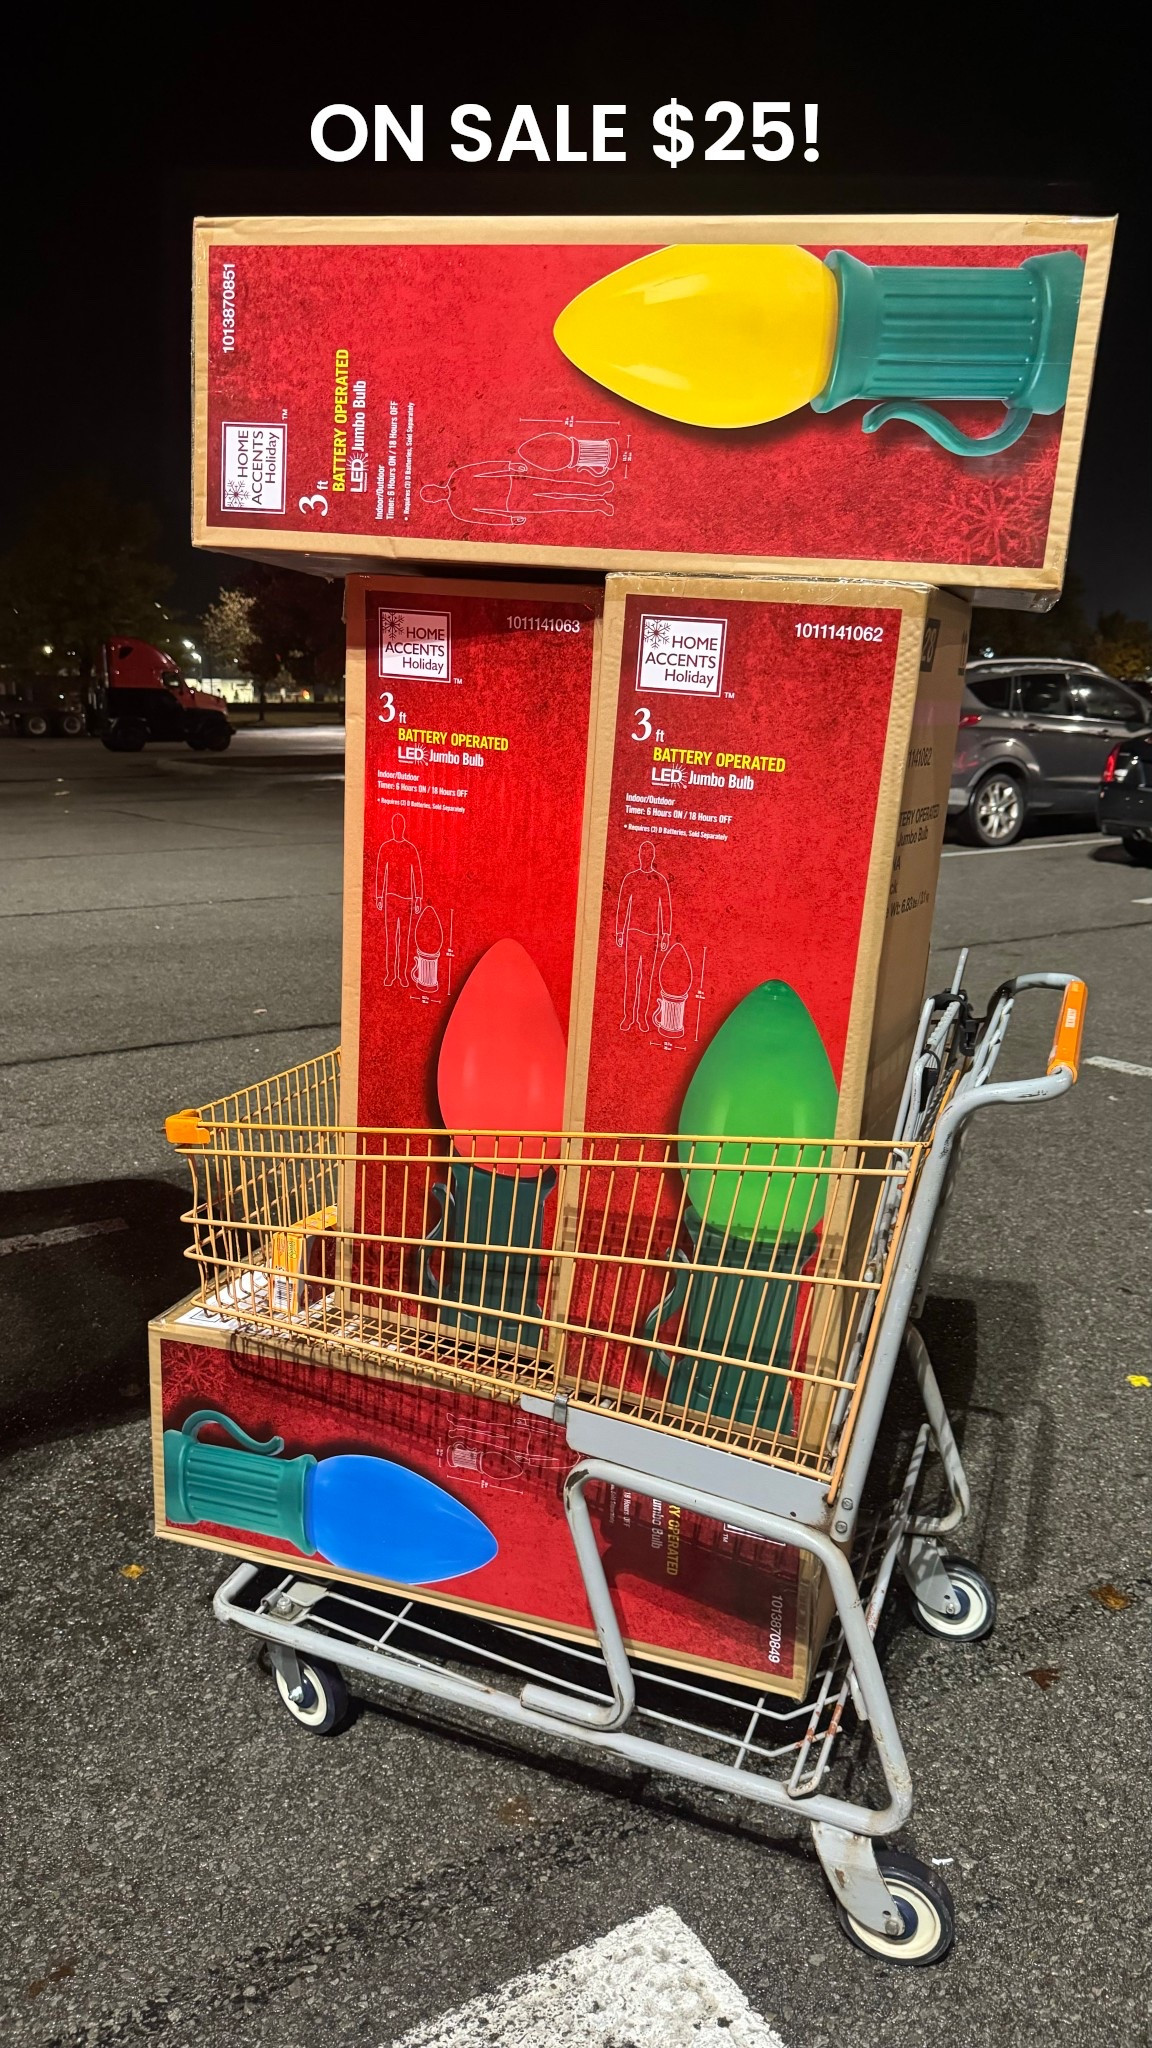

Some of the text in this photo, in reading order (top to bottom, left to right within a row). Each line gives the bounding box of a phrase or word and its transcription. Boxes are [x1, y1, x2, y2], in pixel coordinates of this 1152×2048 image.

[222, 263, 236, 354] 1013870851
[389, 400, 399, 416] OFF
[332, 349, 349, 492] BATTERY OPERATED
[389, 417, 398, 439] Hours
[350, 380, 367, 493] LED Jumbo Bulb
[388, 440, 397, 449] 18
[237, 430, 249, 478] HOME
[264, 431, 280, 484] Holiday
[388, 455, 397, 467] ON
[251, 430, 264, 506] ACCENTS
[387, 468, 397, 490] Hours
[298, 480, 329, 517] 3 ft
[375, 464, 386, 520] Indoor/Outdoor
[386, 497, 395, 520] Timer:
[406, 626, 445, 641] HOME
[506, 616, 581, 633] 1011141063
[794, 623, 884, 642] 1011141062
[385, 642, 445, 657] ACCENTS
[671, 636, 718, 651] HOME
[402, 657, 444, 674] Holiday
[645, 652, 717, 669] ACCENTS
[664, 669, 714, 688] Holiday
[378, 692, 407, 724] 3 ft
[631, 707, 665, 743] 3 ft
[398, 727, 509, 751] BATTERY OPERATED
[397, 745, 485, 768] LED Jumbo Bulb
[653, 746, 786, 772] BATTERY OPERATED
[377, 769, 420, 782] Indoor/Outdoor
[651, 766, 754, 790] LED Jumbo Bulb
[377, 780, 395, 790] Timer:
[400, 783, 418, 793] Hours
[418, 785, 427, 793] ON
[432, 786, 439, 795] 18
[439, 787, 456, 797] Hours
[456, 789, 469, 798] OFF
[625, 793, 676, 806] Indoor/Outdoor
[625, 805, 646, 815] Timer:
[646, 807, 652, 815] 6
[652, 808, 672, 818] Hours
[673, 810, 683, 819] ON
[689, 812, 696, 820] 18
[697, 812, 718, 823] Hours
[718, 815, 733, 824] OFF
[623, 1499, 631, 1516] Hours
[650, 1498, 665, 1549] umbo Bulb
[666, 1519, 680, 1576] OPERATED
[768, 1595, 783, 1664] 1013870849
